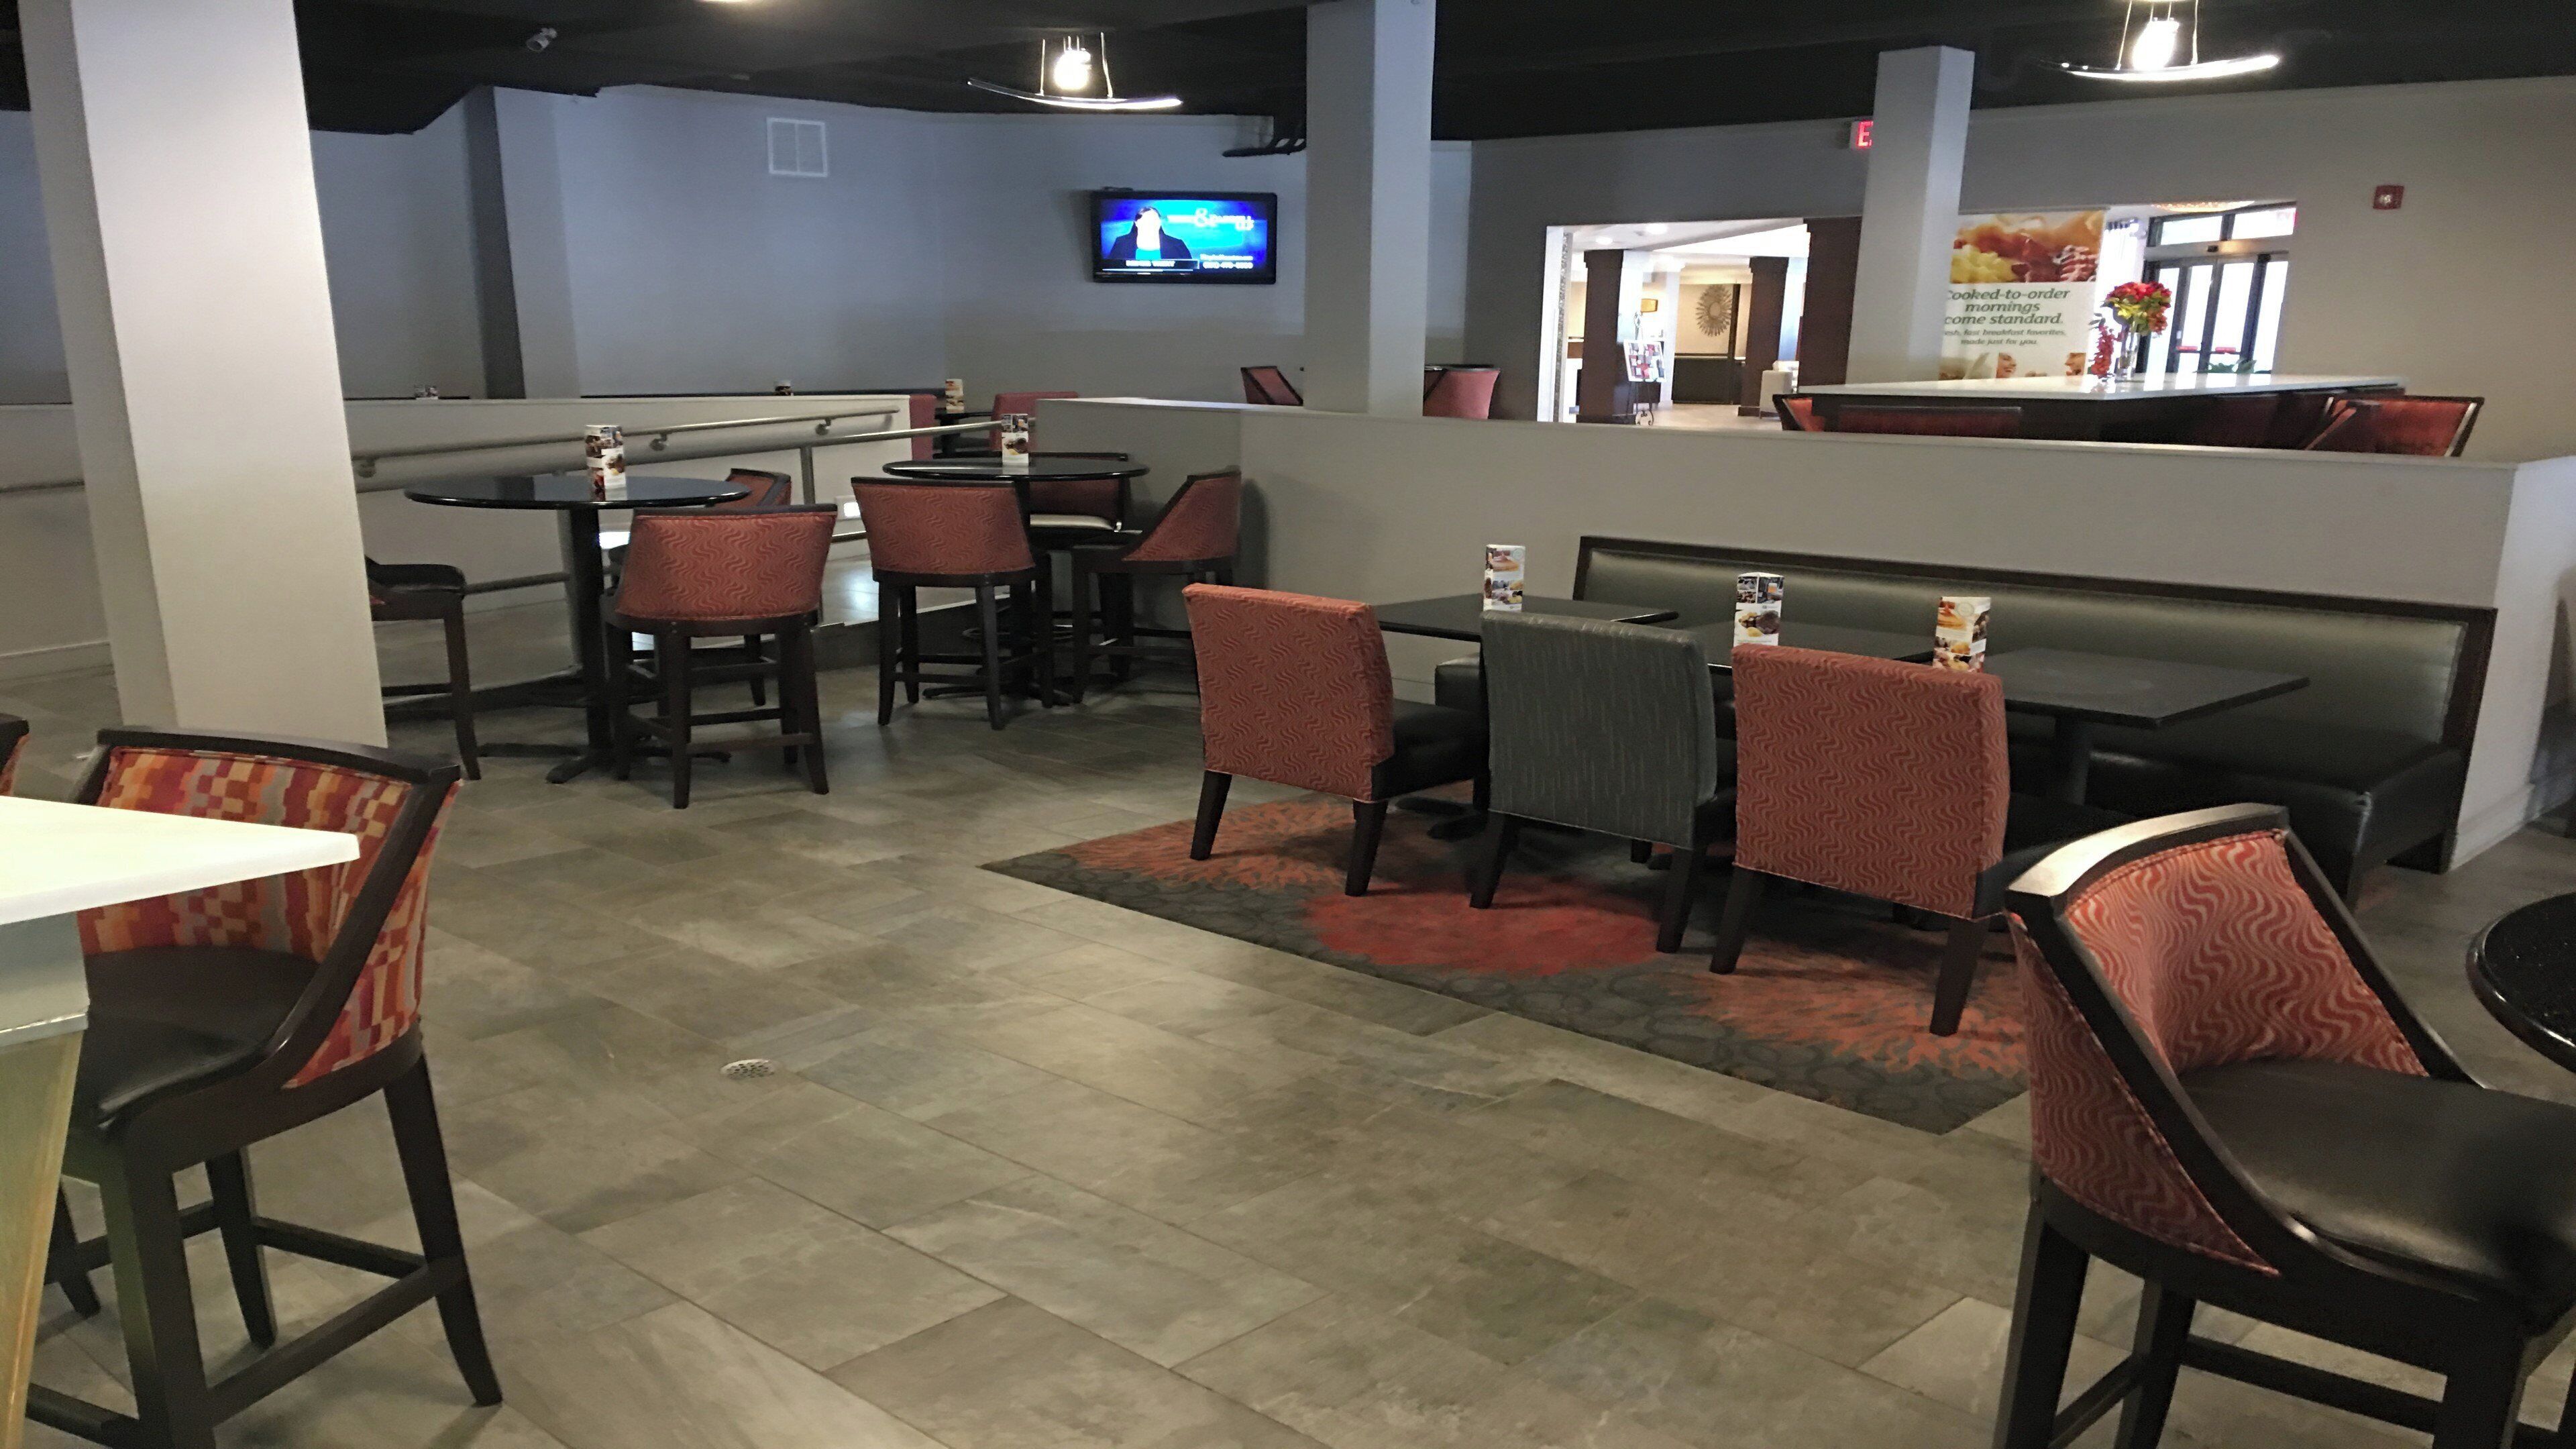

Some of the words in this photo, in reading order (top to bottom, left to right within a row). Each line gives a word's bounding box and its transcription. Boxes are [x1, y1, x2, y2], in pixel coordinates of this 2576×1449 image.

[1966, 302, 2040, 314] mornings
[1945, 316, 1986, 325] come
[1989, 313, 2063, 325] standard.
